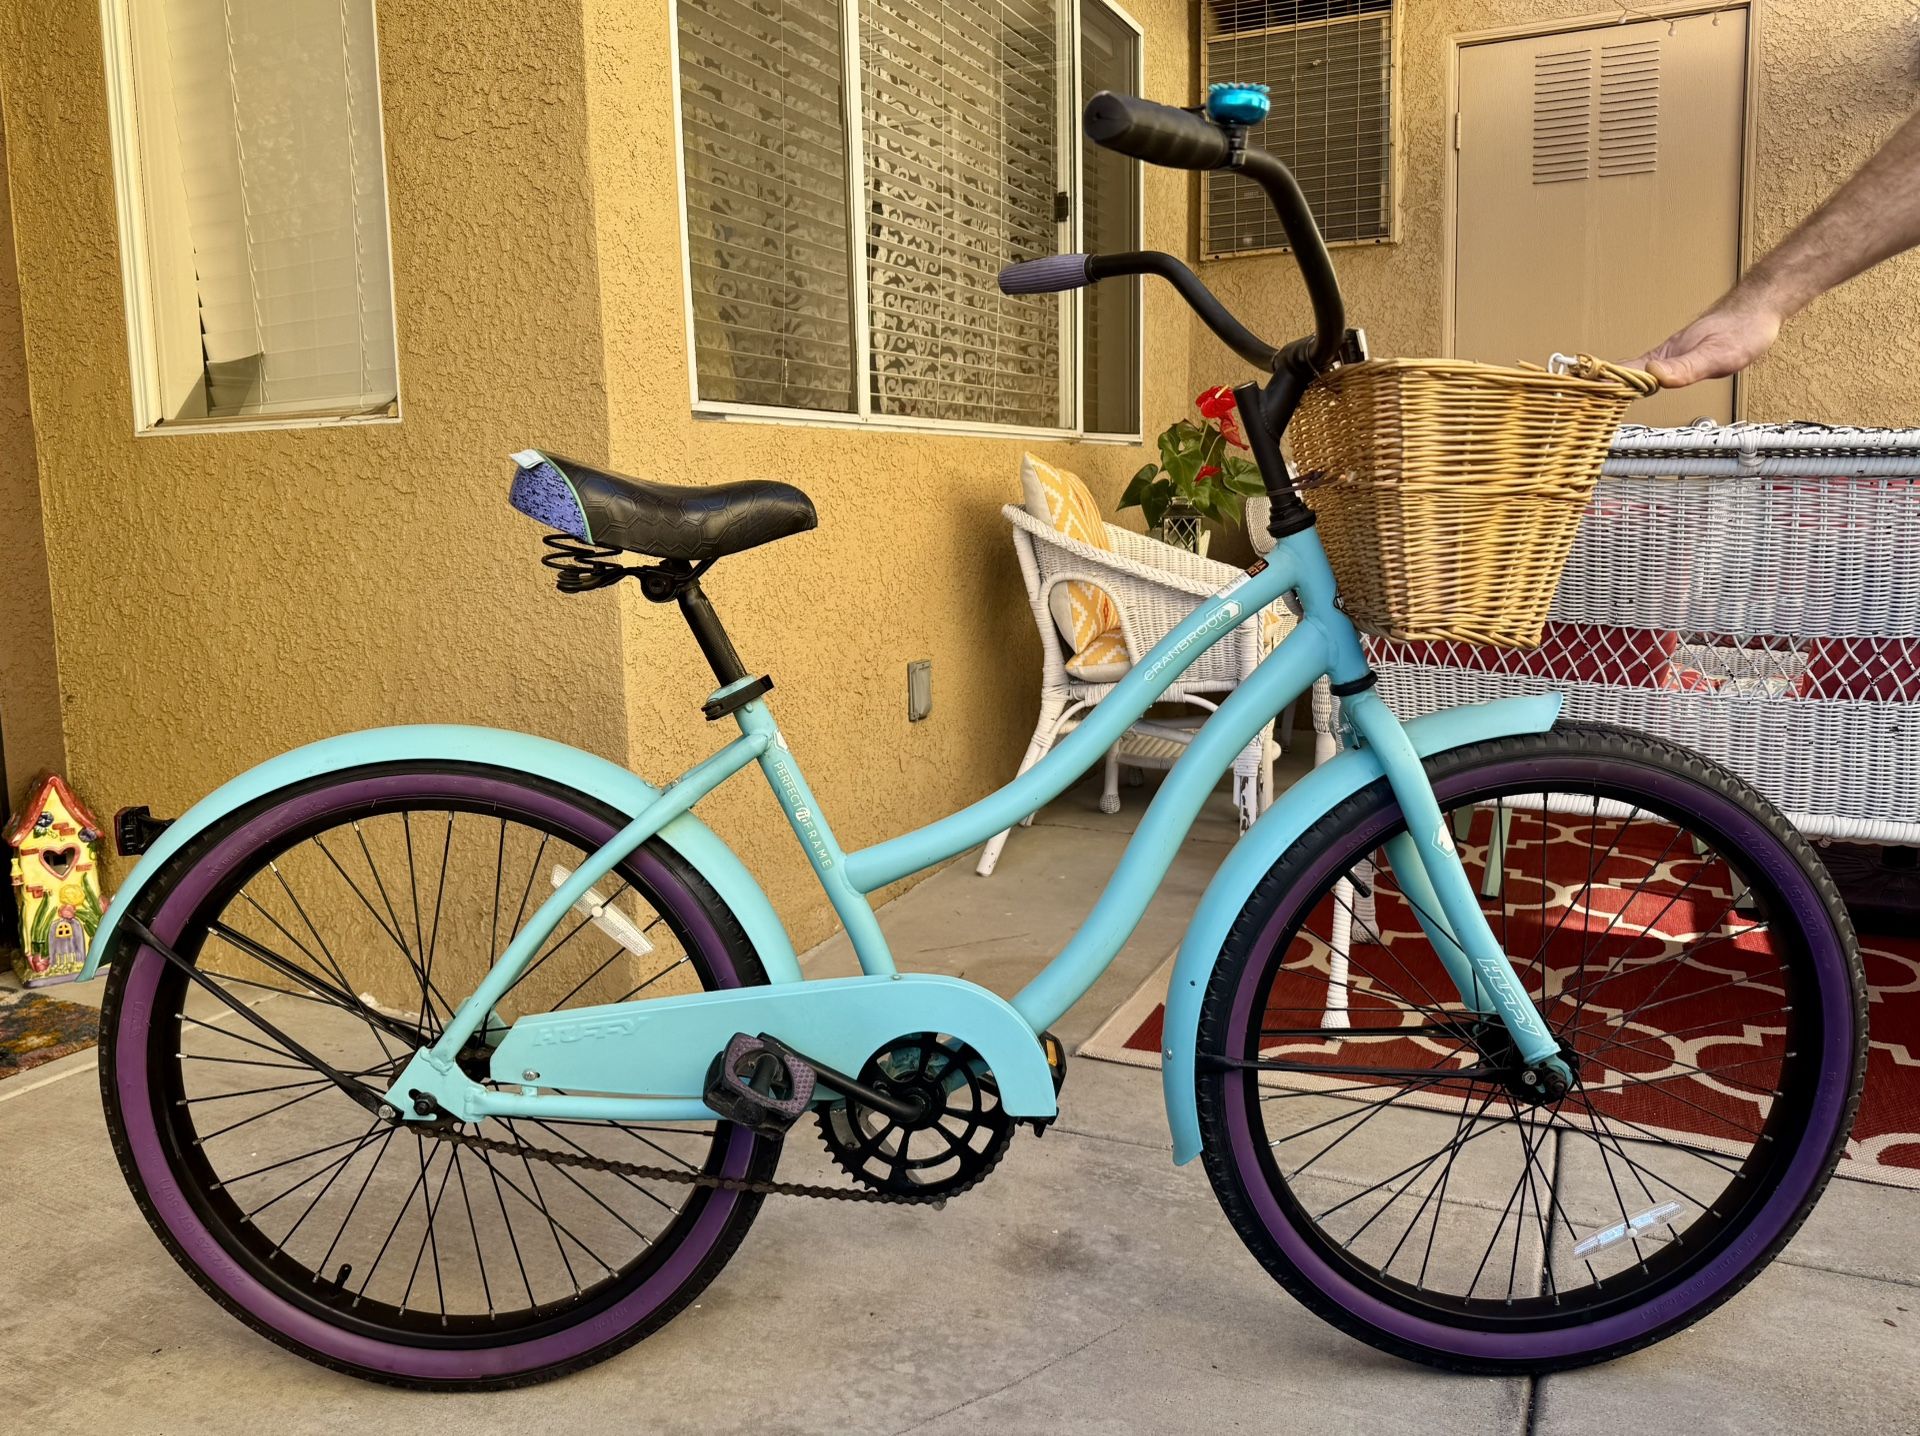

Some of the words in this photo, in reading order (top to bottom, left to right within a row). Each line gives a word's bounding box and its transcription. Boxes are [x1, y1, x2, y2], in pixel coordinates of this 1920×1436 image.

[1144, 609, 1230, 682] CRANBROOK
[774, 761, 803, 807] PERFECT
[803, 819, 832, 868] FRAME
[533, 1016, 650, 1047] HUFFY
[1477, 958, 1542, 1037] HUFFY
